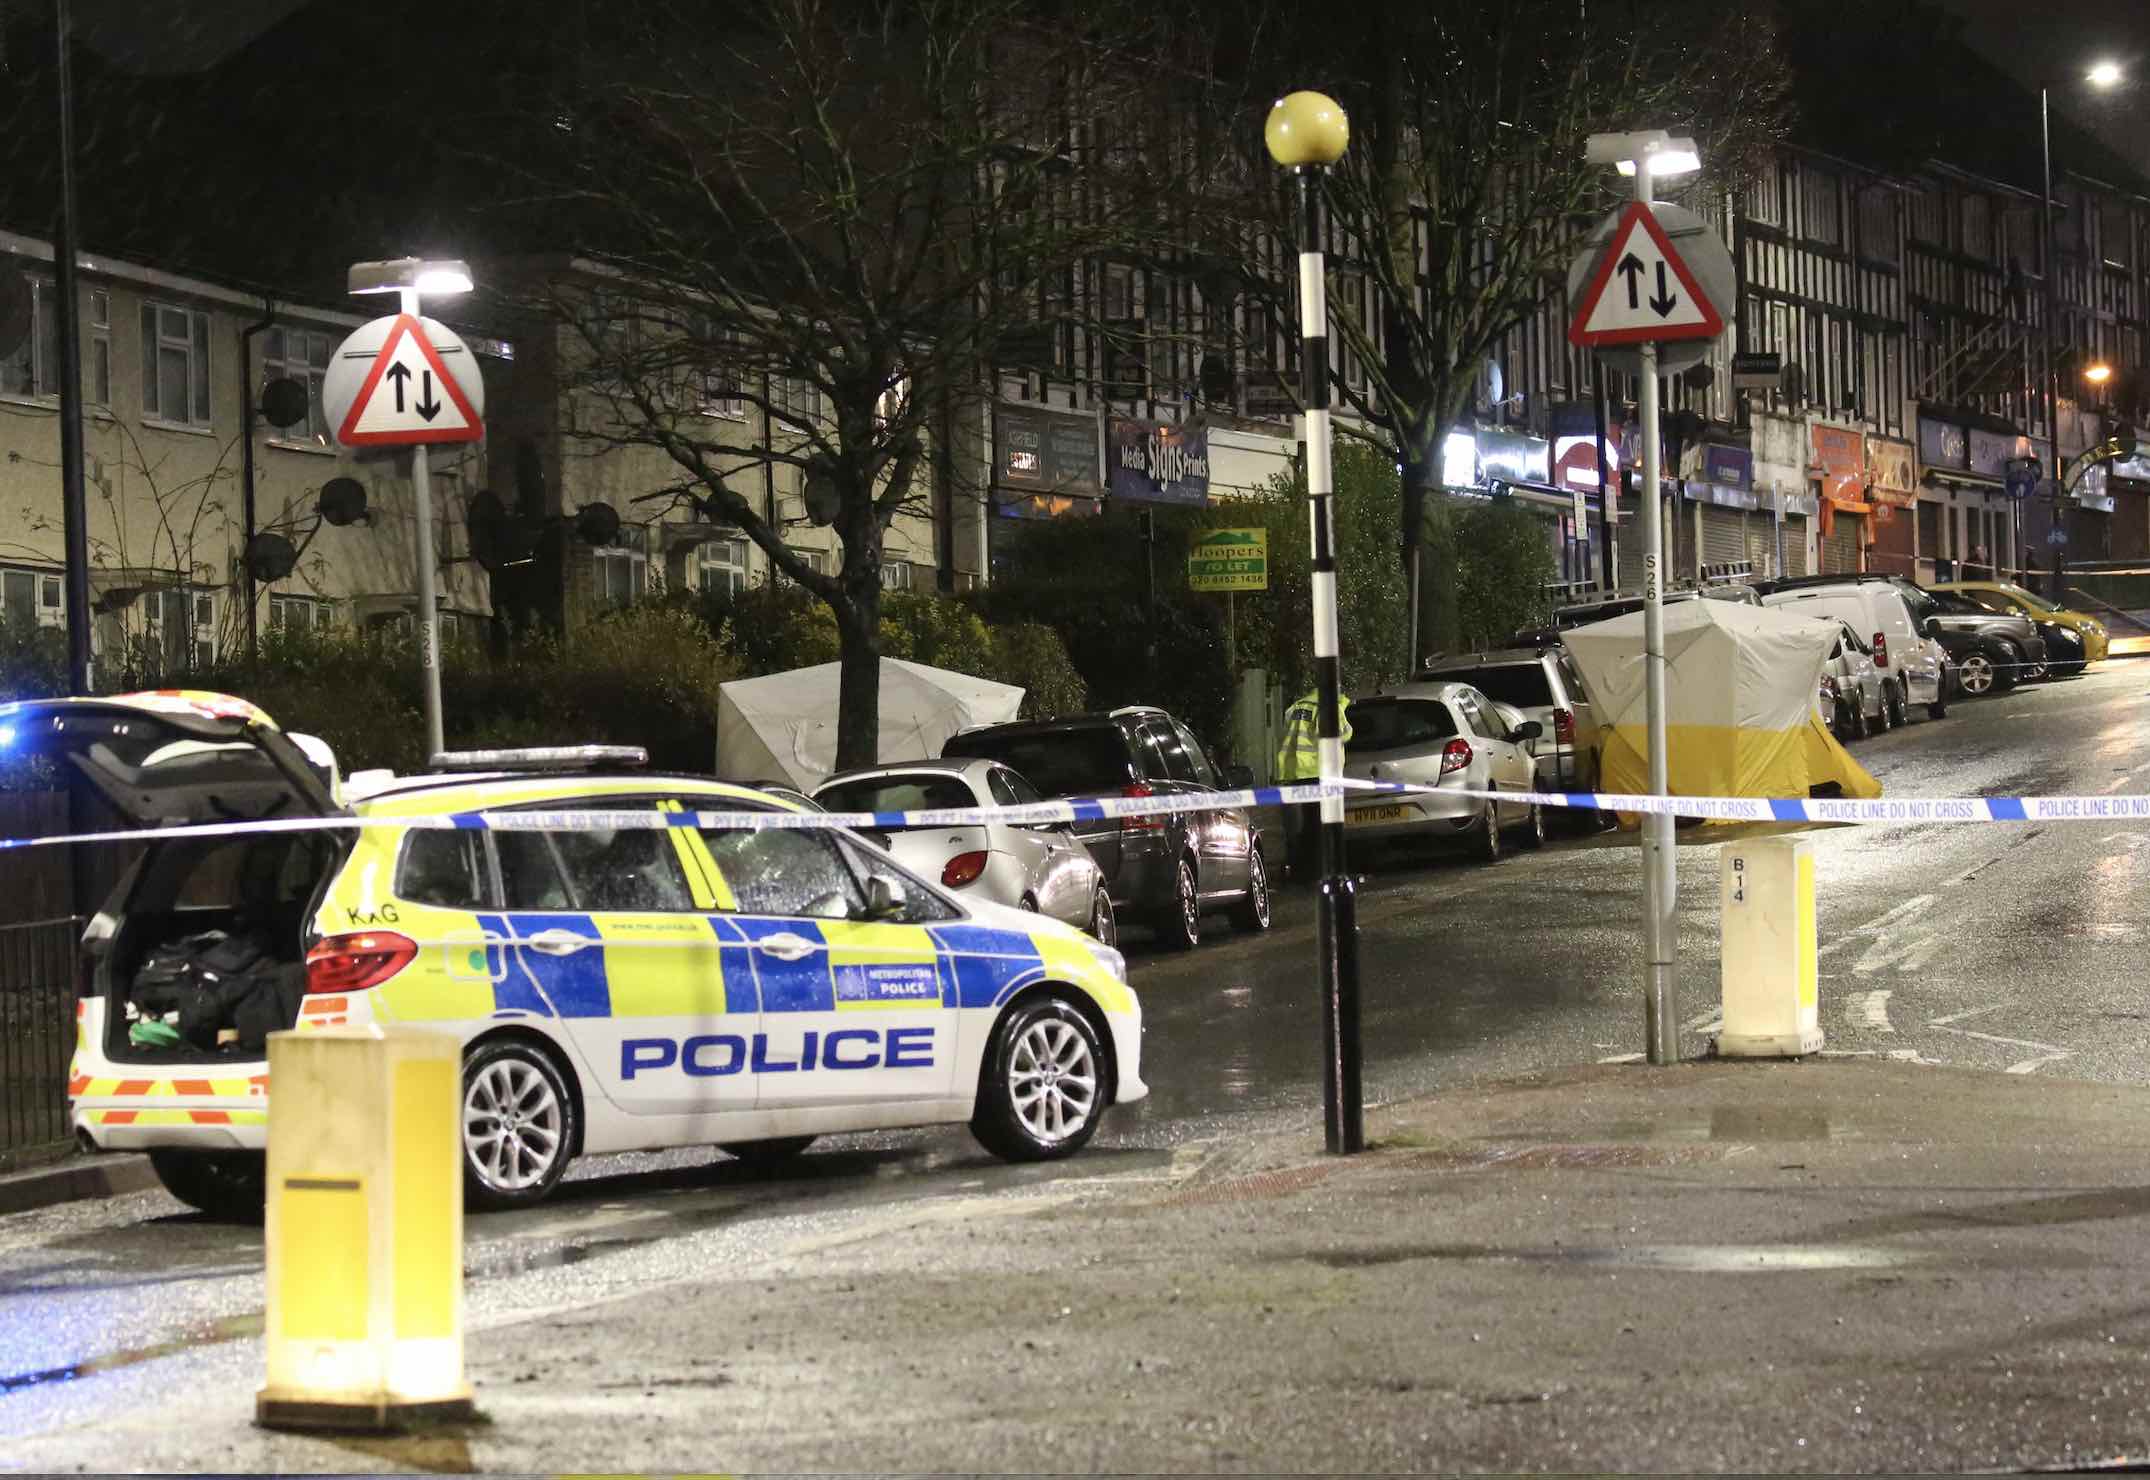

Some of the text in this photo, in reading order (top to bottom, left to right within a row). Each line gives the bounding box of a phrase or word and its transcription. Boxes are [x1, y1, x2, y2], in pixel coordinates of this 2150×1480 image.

[1121, 444, 1146, 471] Media
[1147, 433, 1183, 493] Signs
[1183, 452, 1207, 479] Prints
[1191, 545, 1264, 560] Hoopers
[1205, 562, 1249, 572] TO LET
[1646, 554, 1656, 601] S26
[1611, 798, 1757, 817] POLICE LINE DO NOT CROSS
[1818, 802, 1974, 818] POLICE LINE DO NOT CROSS
[2039, 800, 2080, 816] POLICE
[2083, 799, 2109, 816] LINE
[2113, 799, 2129, 815] DO
[1733, 858, 1744, 902] B14
[868, 968, 933, 980] METROPOLITAN
[879, 981, 927, 995] POLICE
[620, 1027, 935, 1081] POLICE
